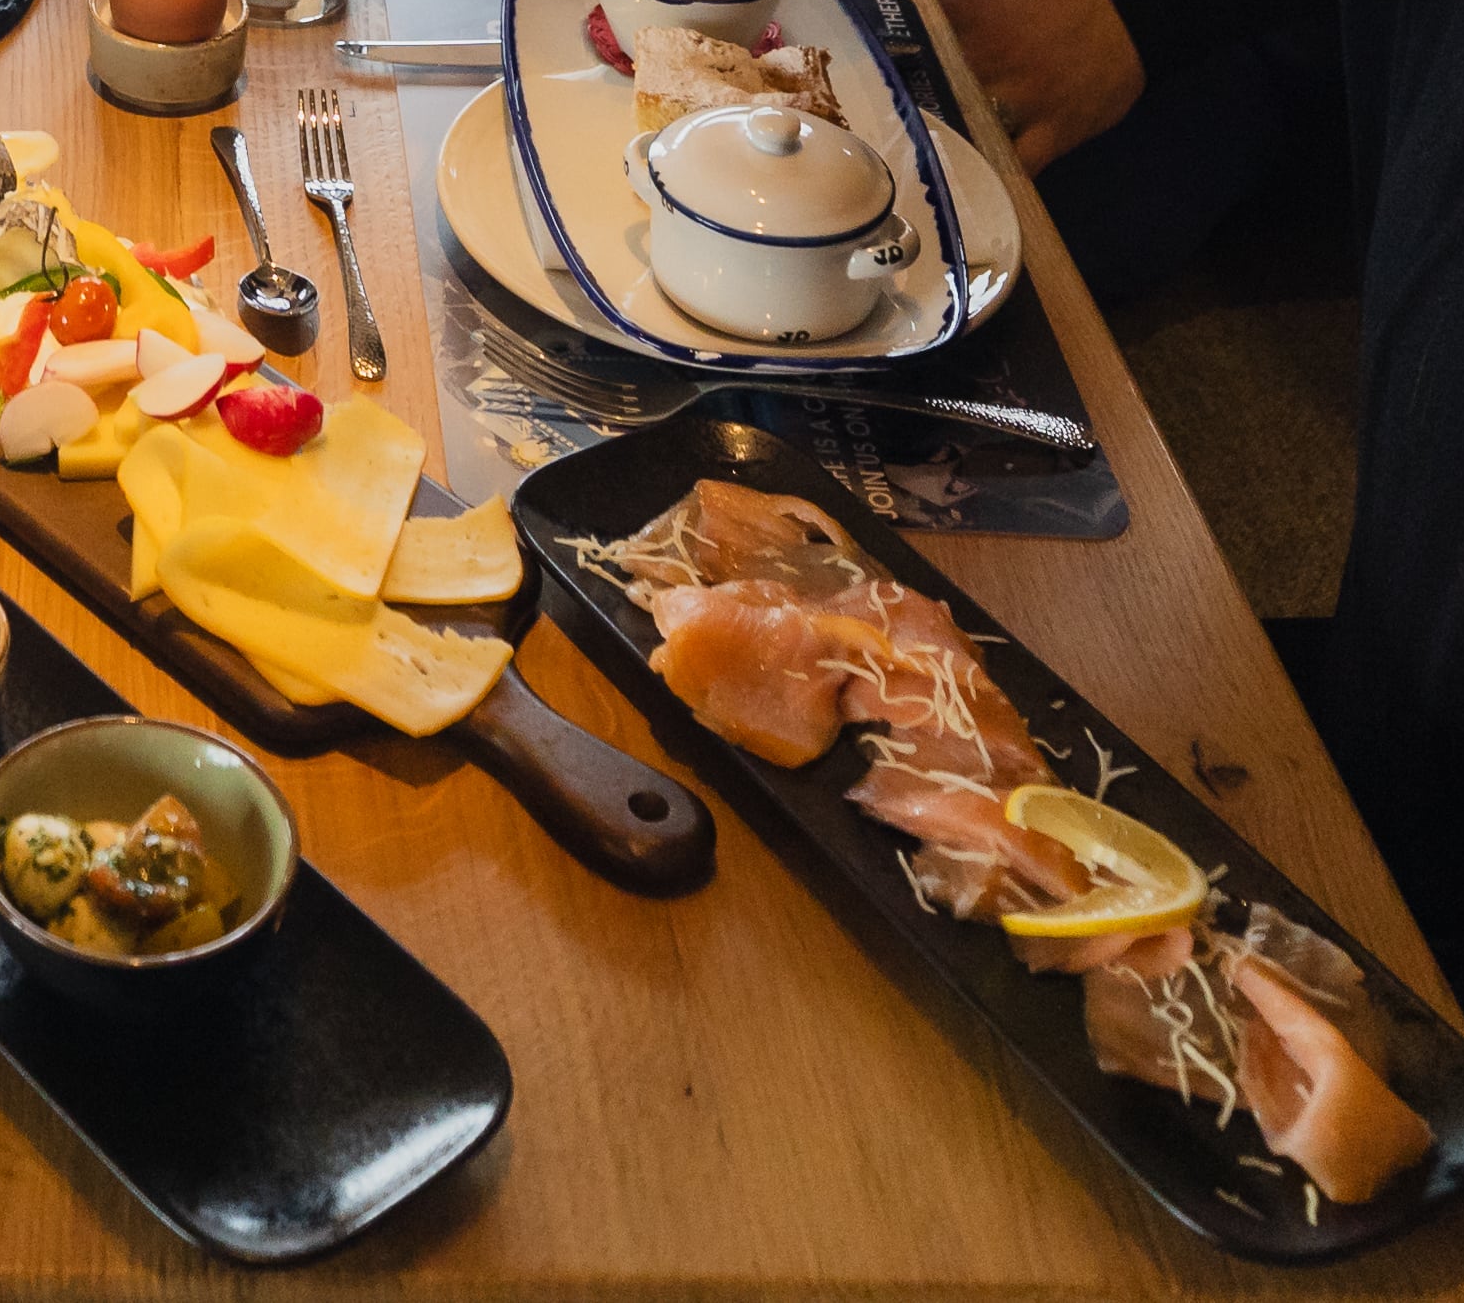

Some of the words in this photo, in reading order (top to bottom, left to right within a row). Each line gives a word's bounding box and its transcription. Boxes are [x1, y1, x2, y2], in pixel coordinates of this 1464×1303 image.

[910, 68, 945, 121] ORIES
[852, 441, 880, 466] US
[859, 469, 900, 521] JOIN
